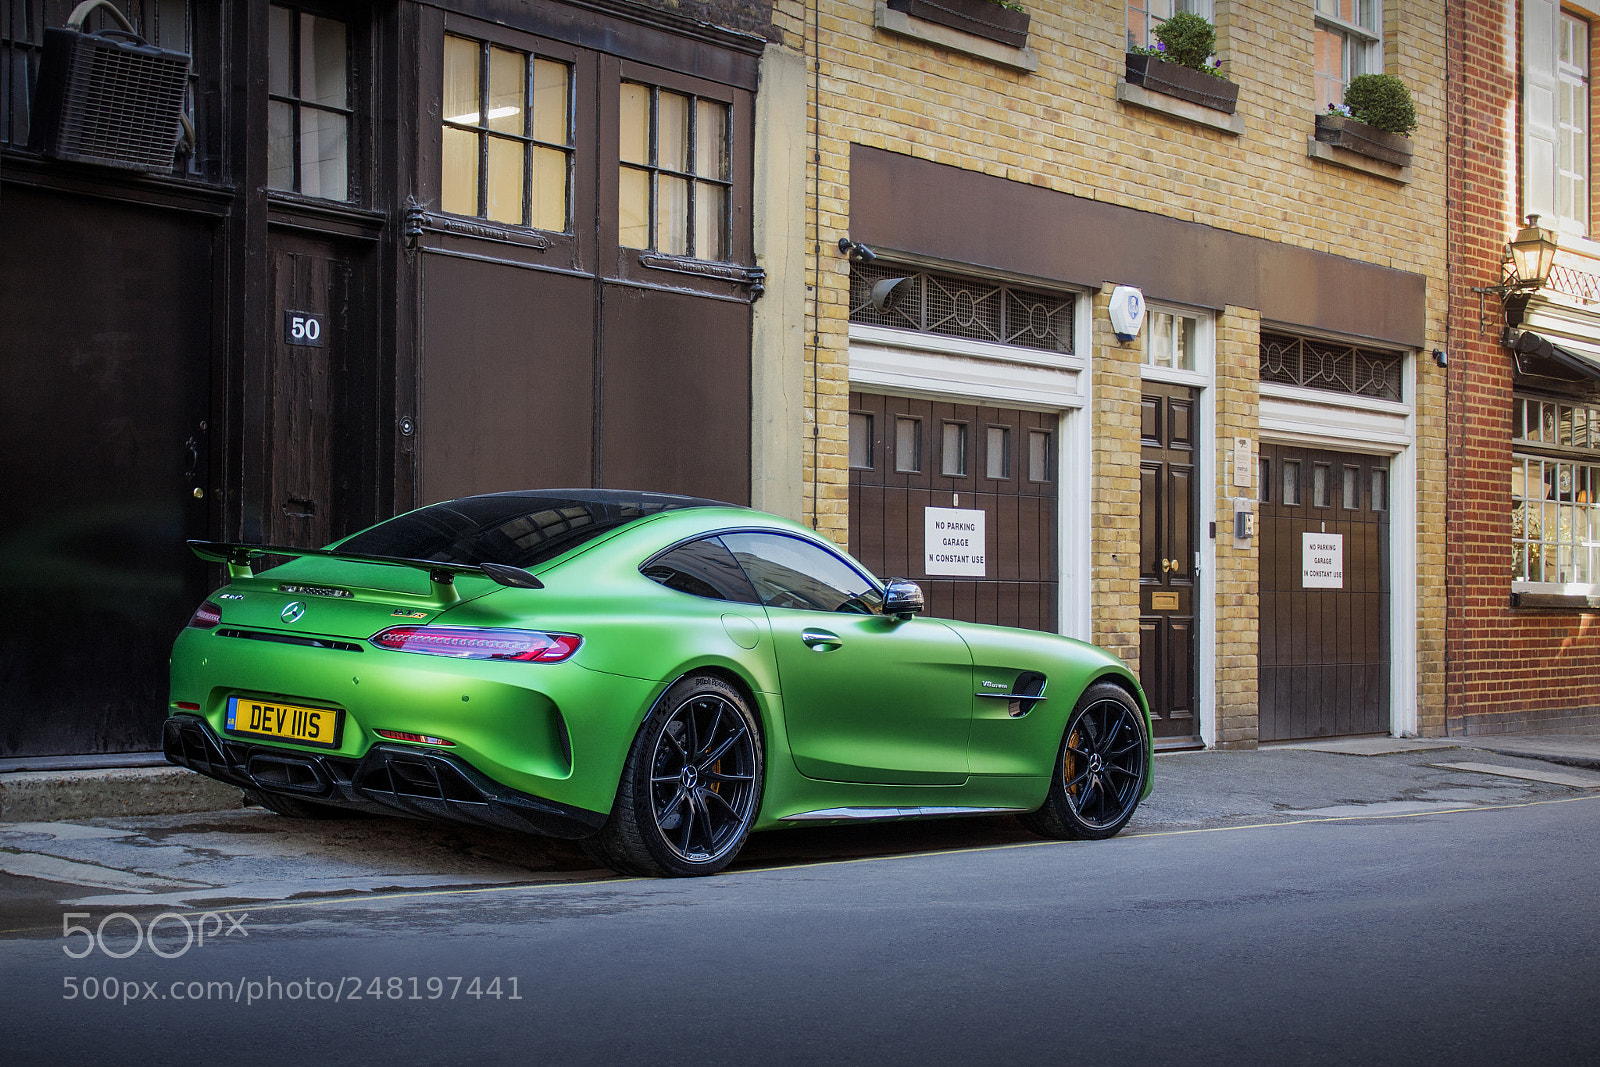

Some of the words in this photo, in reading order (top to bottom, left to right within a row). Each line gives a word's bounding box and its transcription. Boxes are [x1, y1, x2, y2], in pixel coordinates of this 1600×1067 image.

[291, 316, 320, 340] 50
[935, 521, 945, 530] NO
[947, 522, 976, 532] PARKING
[942, 537, 969, 547] GARAGE
[935, 554, 970, 563] CONSTANT
[971, 555, 984, 564] USE
[1314, 557, 1332, 565] GARAGE
[1309, 570, 1333, 578] CONSTANT
[249, 704, 288, 734] DEV
